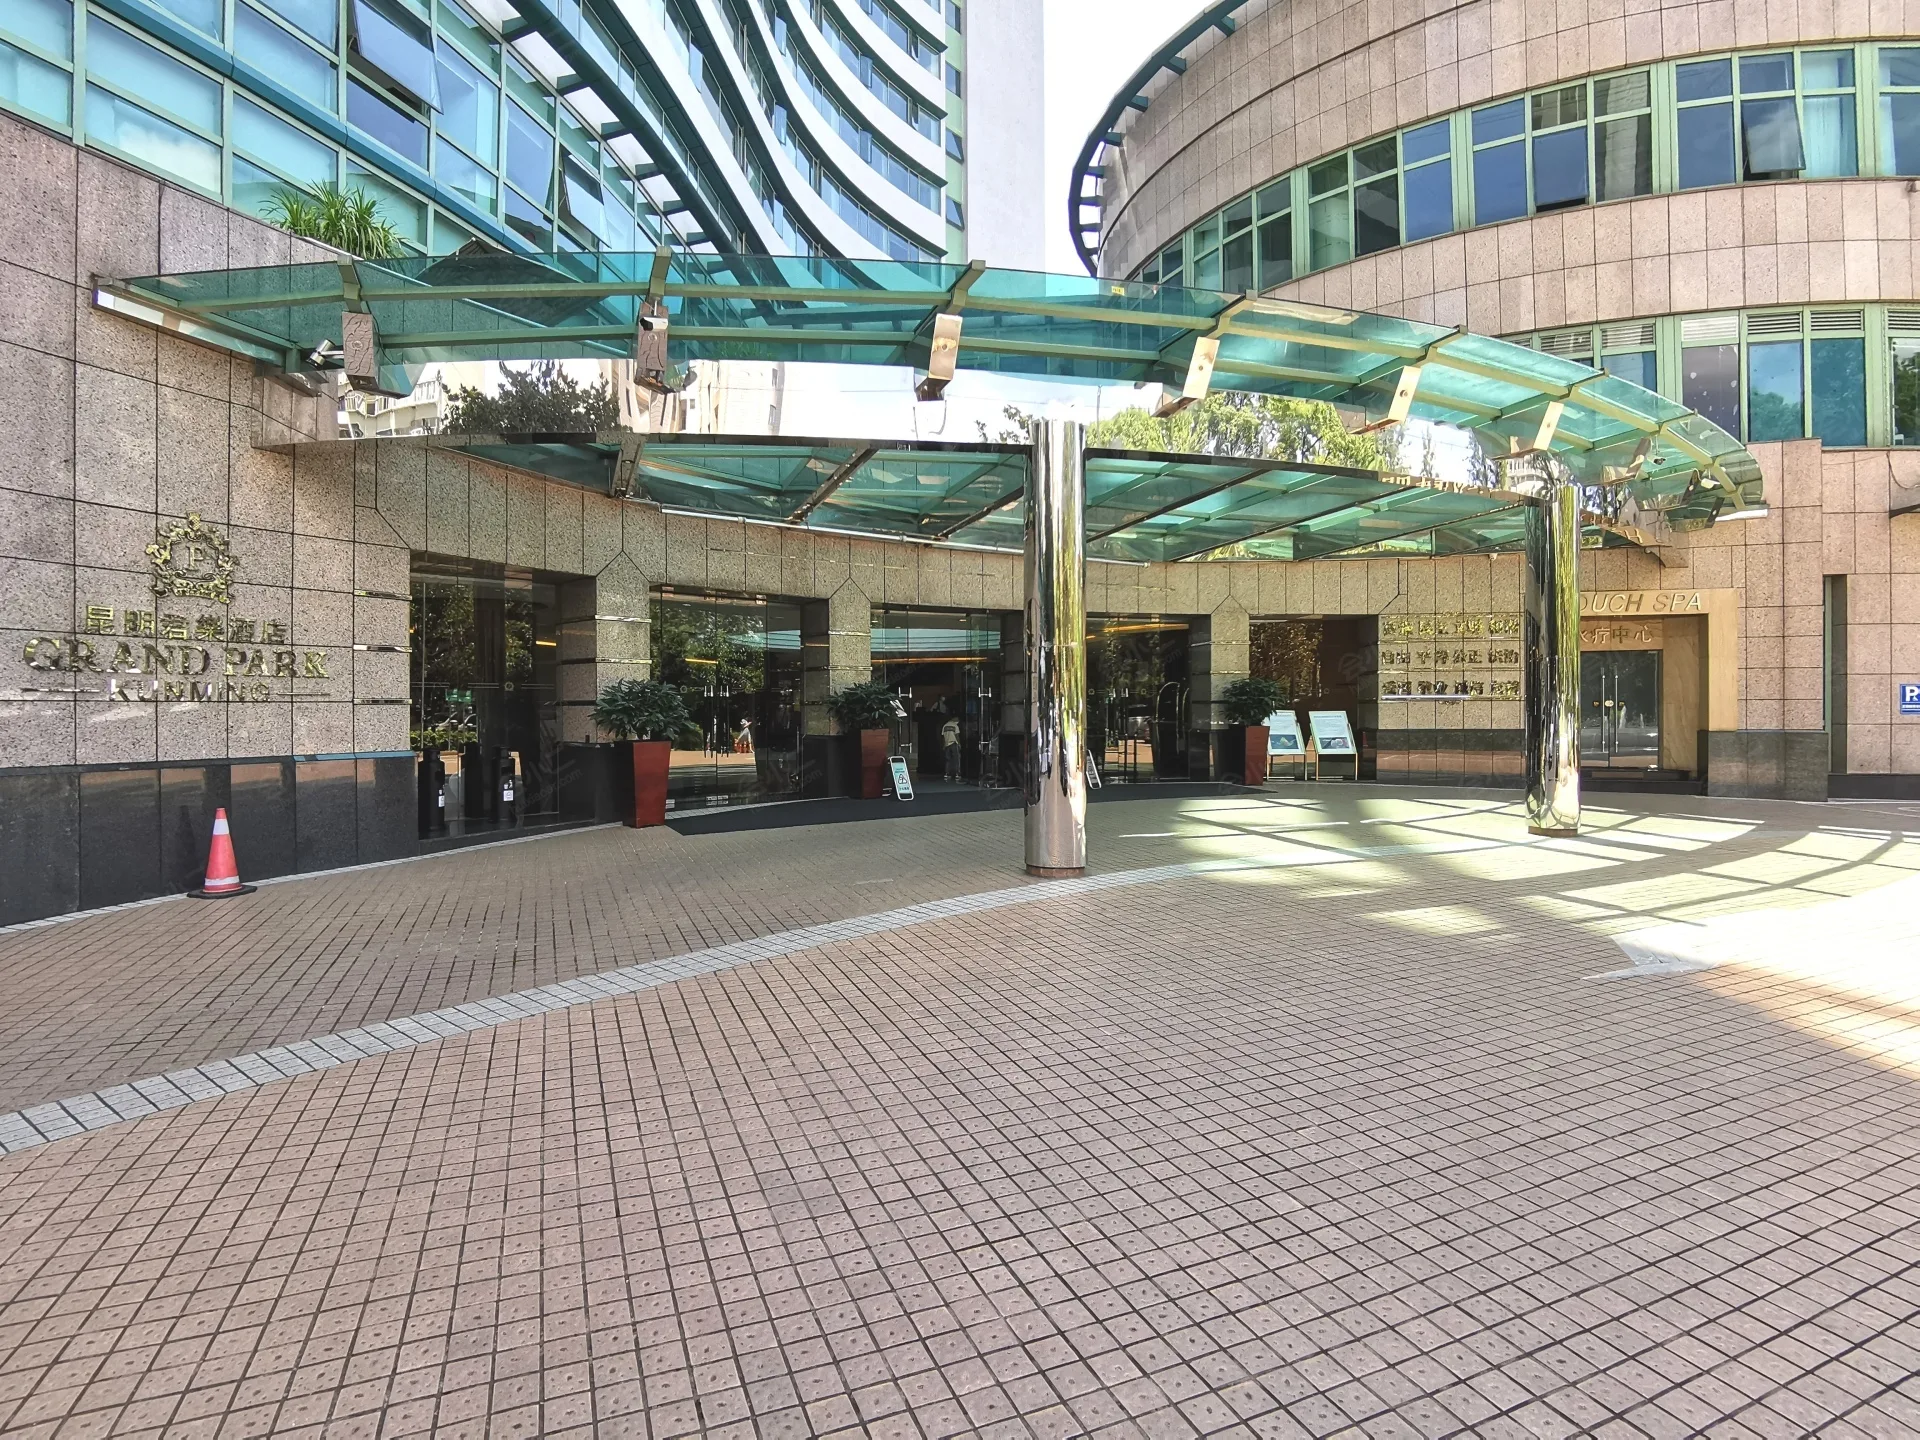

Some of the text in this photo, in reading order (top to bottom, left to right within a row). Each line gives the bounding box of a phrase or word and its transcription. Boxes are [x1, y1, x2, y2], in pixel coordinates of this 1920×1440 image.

[1653, 592, 1701, 613] SPA
[22, 636, 330, 678] GRAND PARK
[107, 678, 270, 701] KUNMING
[1905, 686, 1919, 702] P
